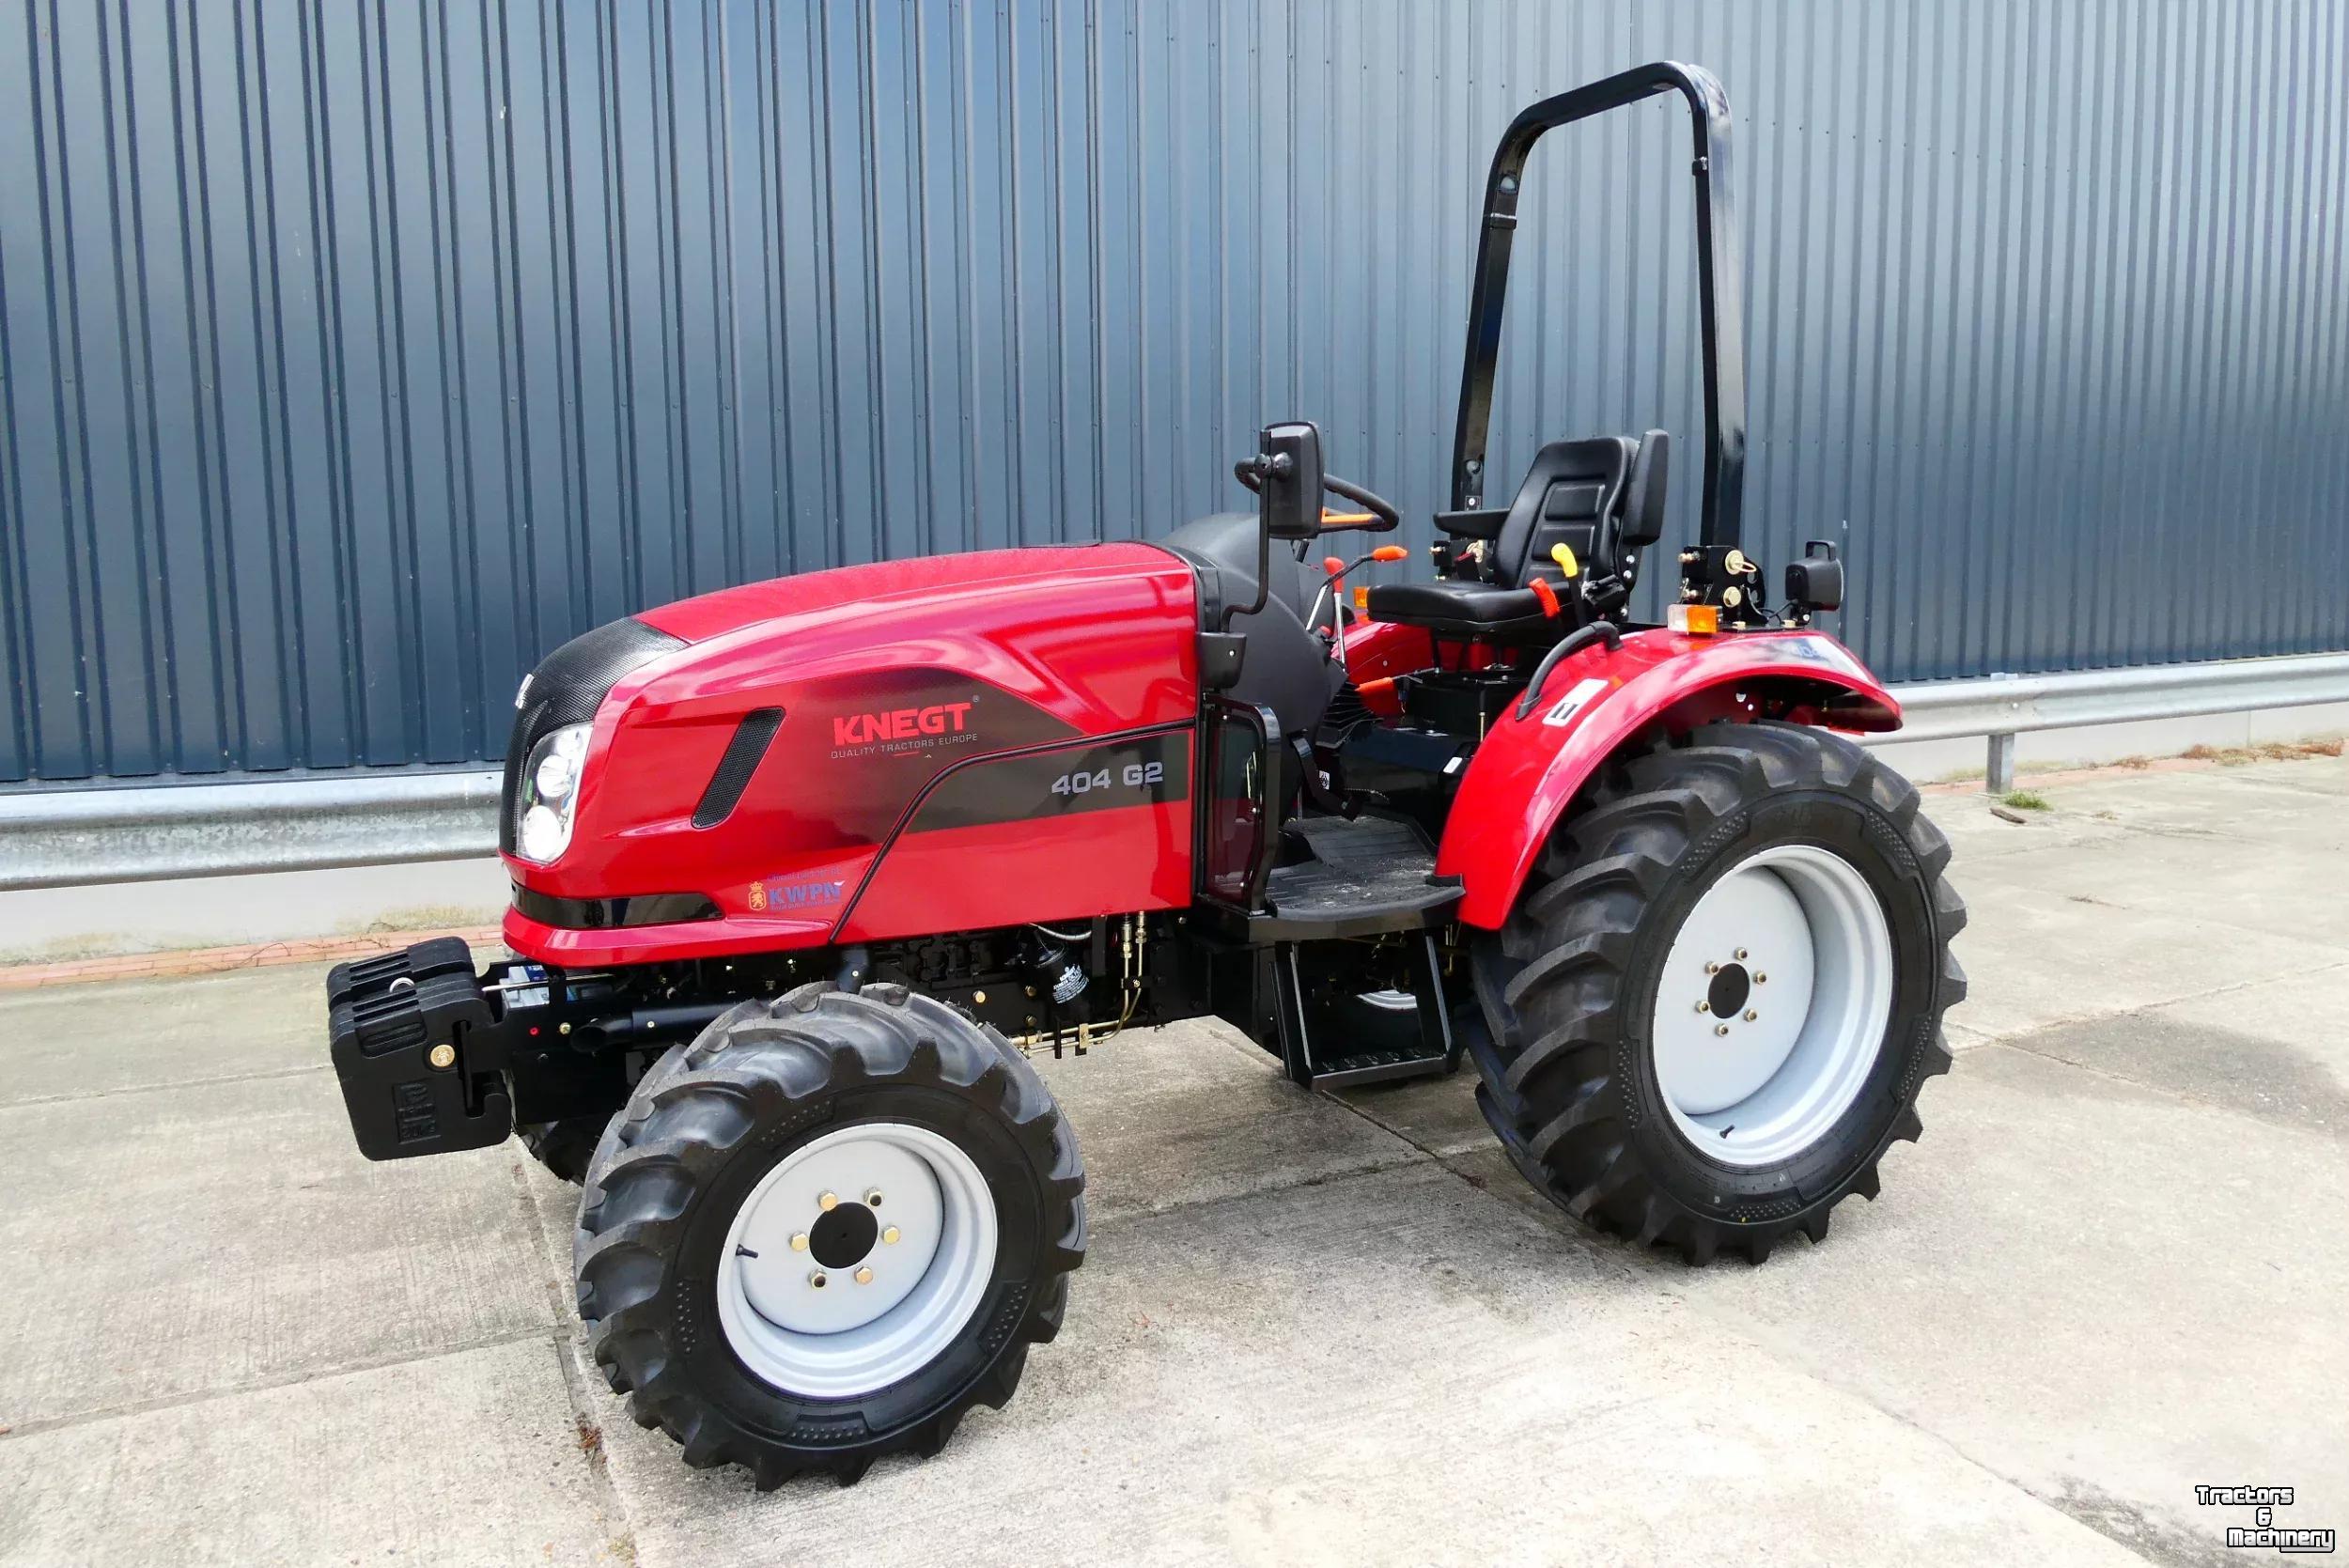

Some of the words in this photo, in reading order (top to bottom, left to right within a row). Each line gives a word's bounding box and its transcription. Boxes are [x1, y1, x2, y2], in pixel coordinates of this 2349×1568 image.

[833, 702, 972, 746] KNEGT
[831, 745, 876, 759] QUALITY
[881, 738, 934, 753] TRACTORS
[939, 733, 978, 746] EUROPE
[1051, 768, 1112, 796] 404
[1123, 761, 1163, 785] G2
[769, 881, 842, 905] KWPN
